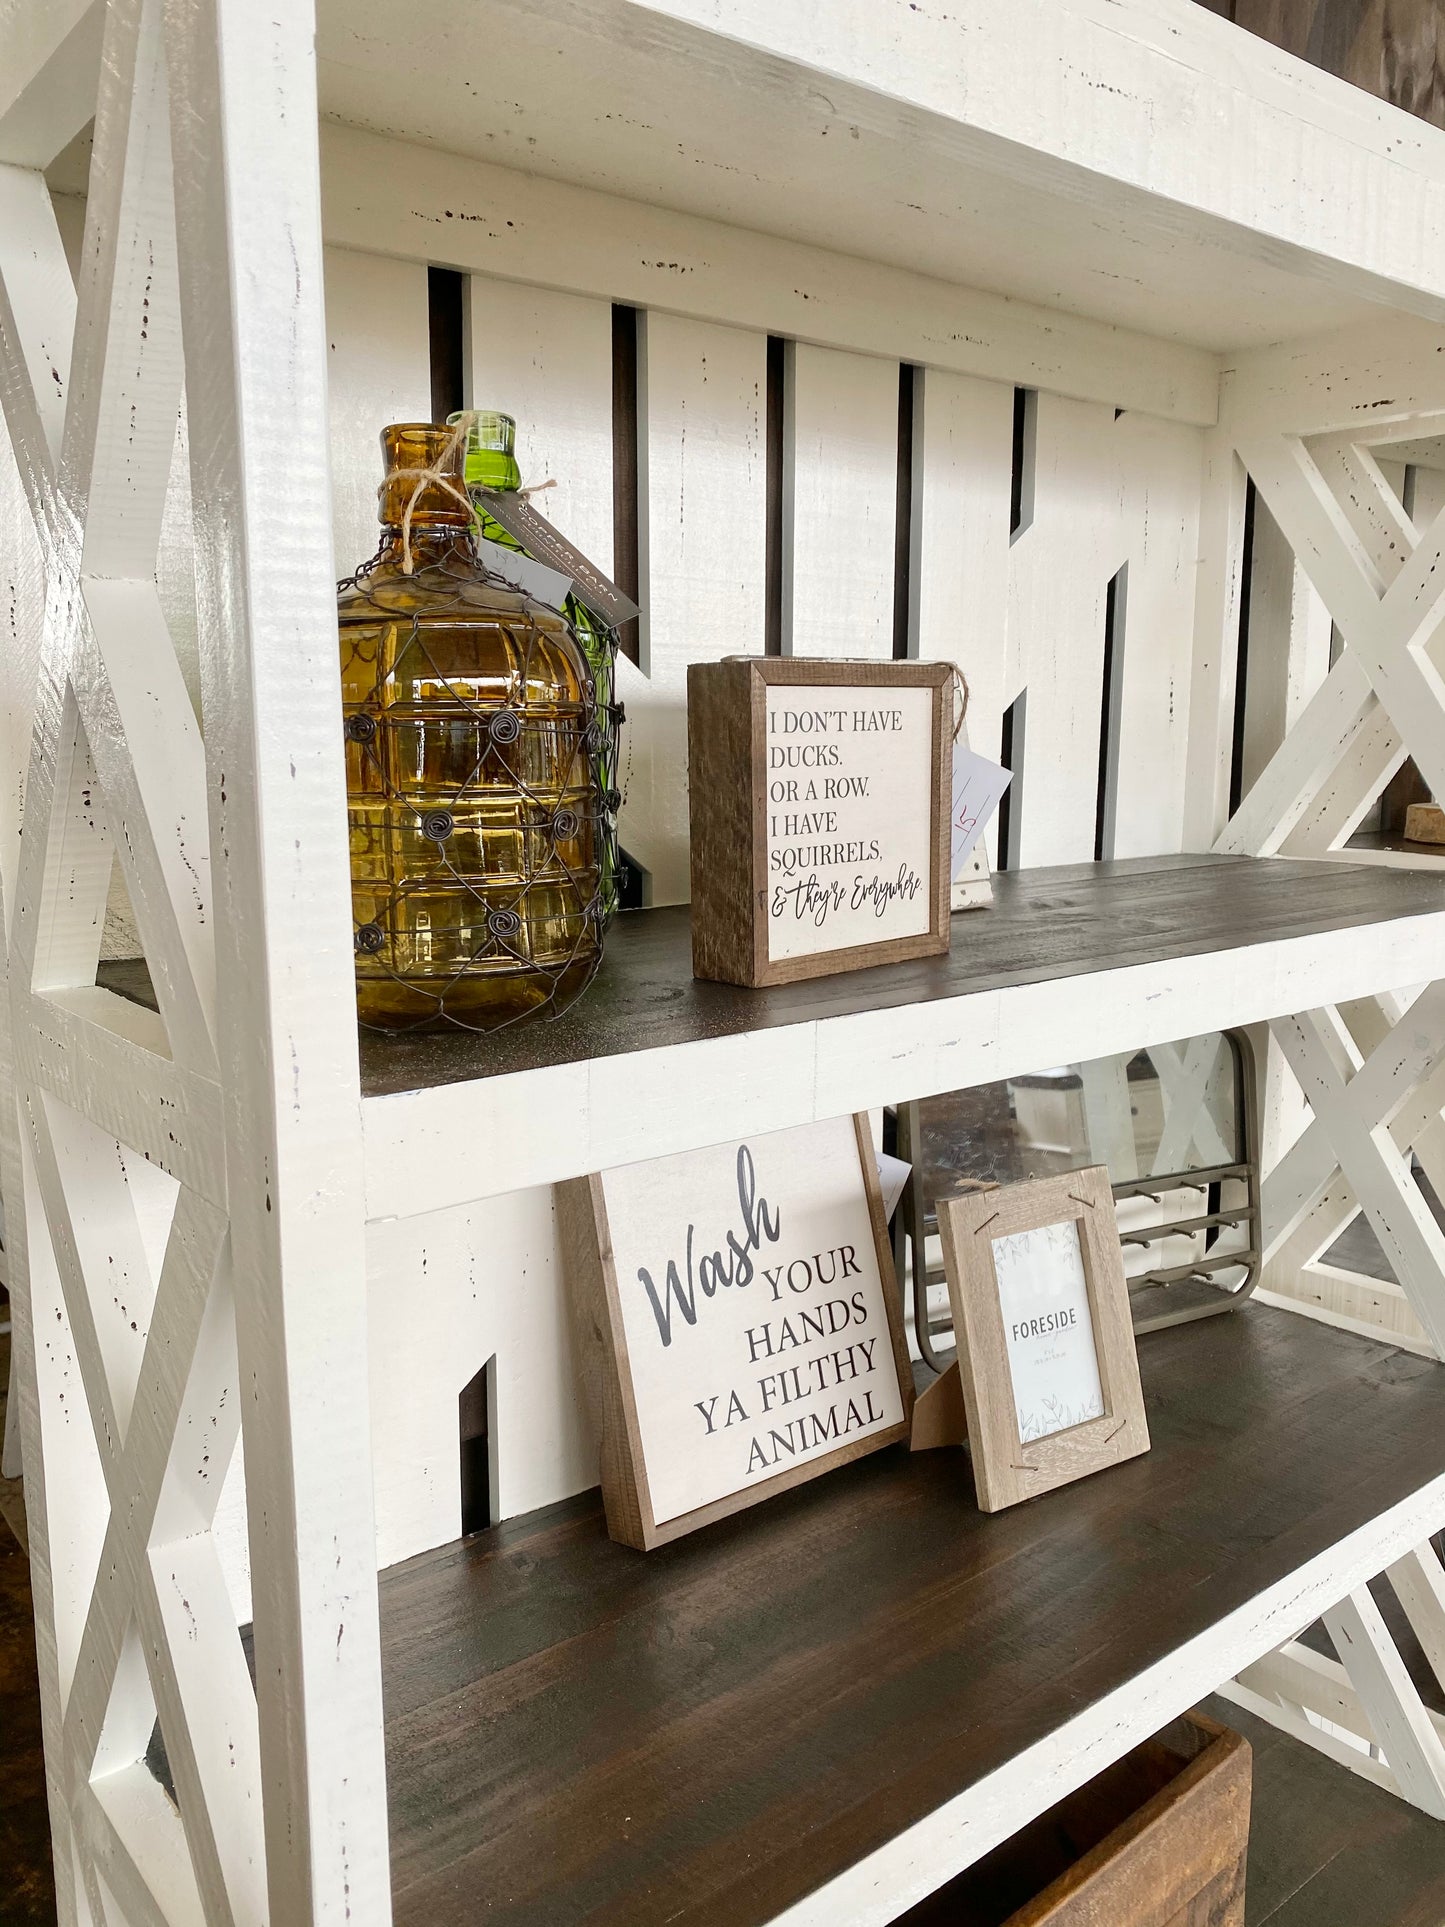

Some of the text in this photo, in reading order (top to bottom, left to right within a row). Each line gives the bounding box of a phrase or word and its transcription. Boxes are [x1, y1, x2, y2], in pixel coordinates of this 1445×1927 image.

[770, 710, 903, 734] I DON'T HAVE
[770, 745, 843, 769] DUCKS.
[770, 776, 870, 803] OR A ROW.
[771, 811, 838, 837] I HAVE
[770, 840, 883, 877] SQUIRRELS,
[771, 885, 788, 918] &
[637, 1144, 780, 1347] Wash
[761, 1245, 862, 1302] YOUR
[744, 1291, 868, 1363] HANDS
[1012, 1308, 1077, 1341] FORESIDE
[694, 1337, 878, 1435] YA FILTHY
[745, 1390, 884, 1475] ANIMAL
